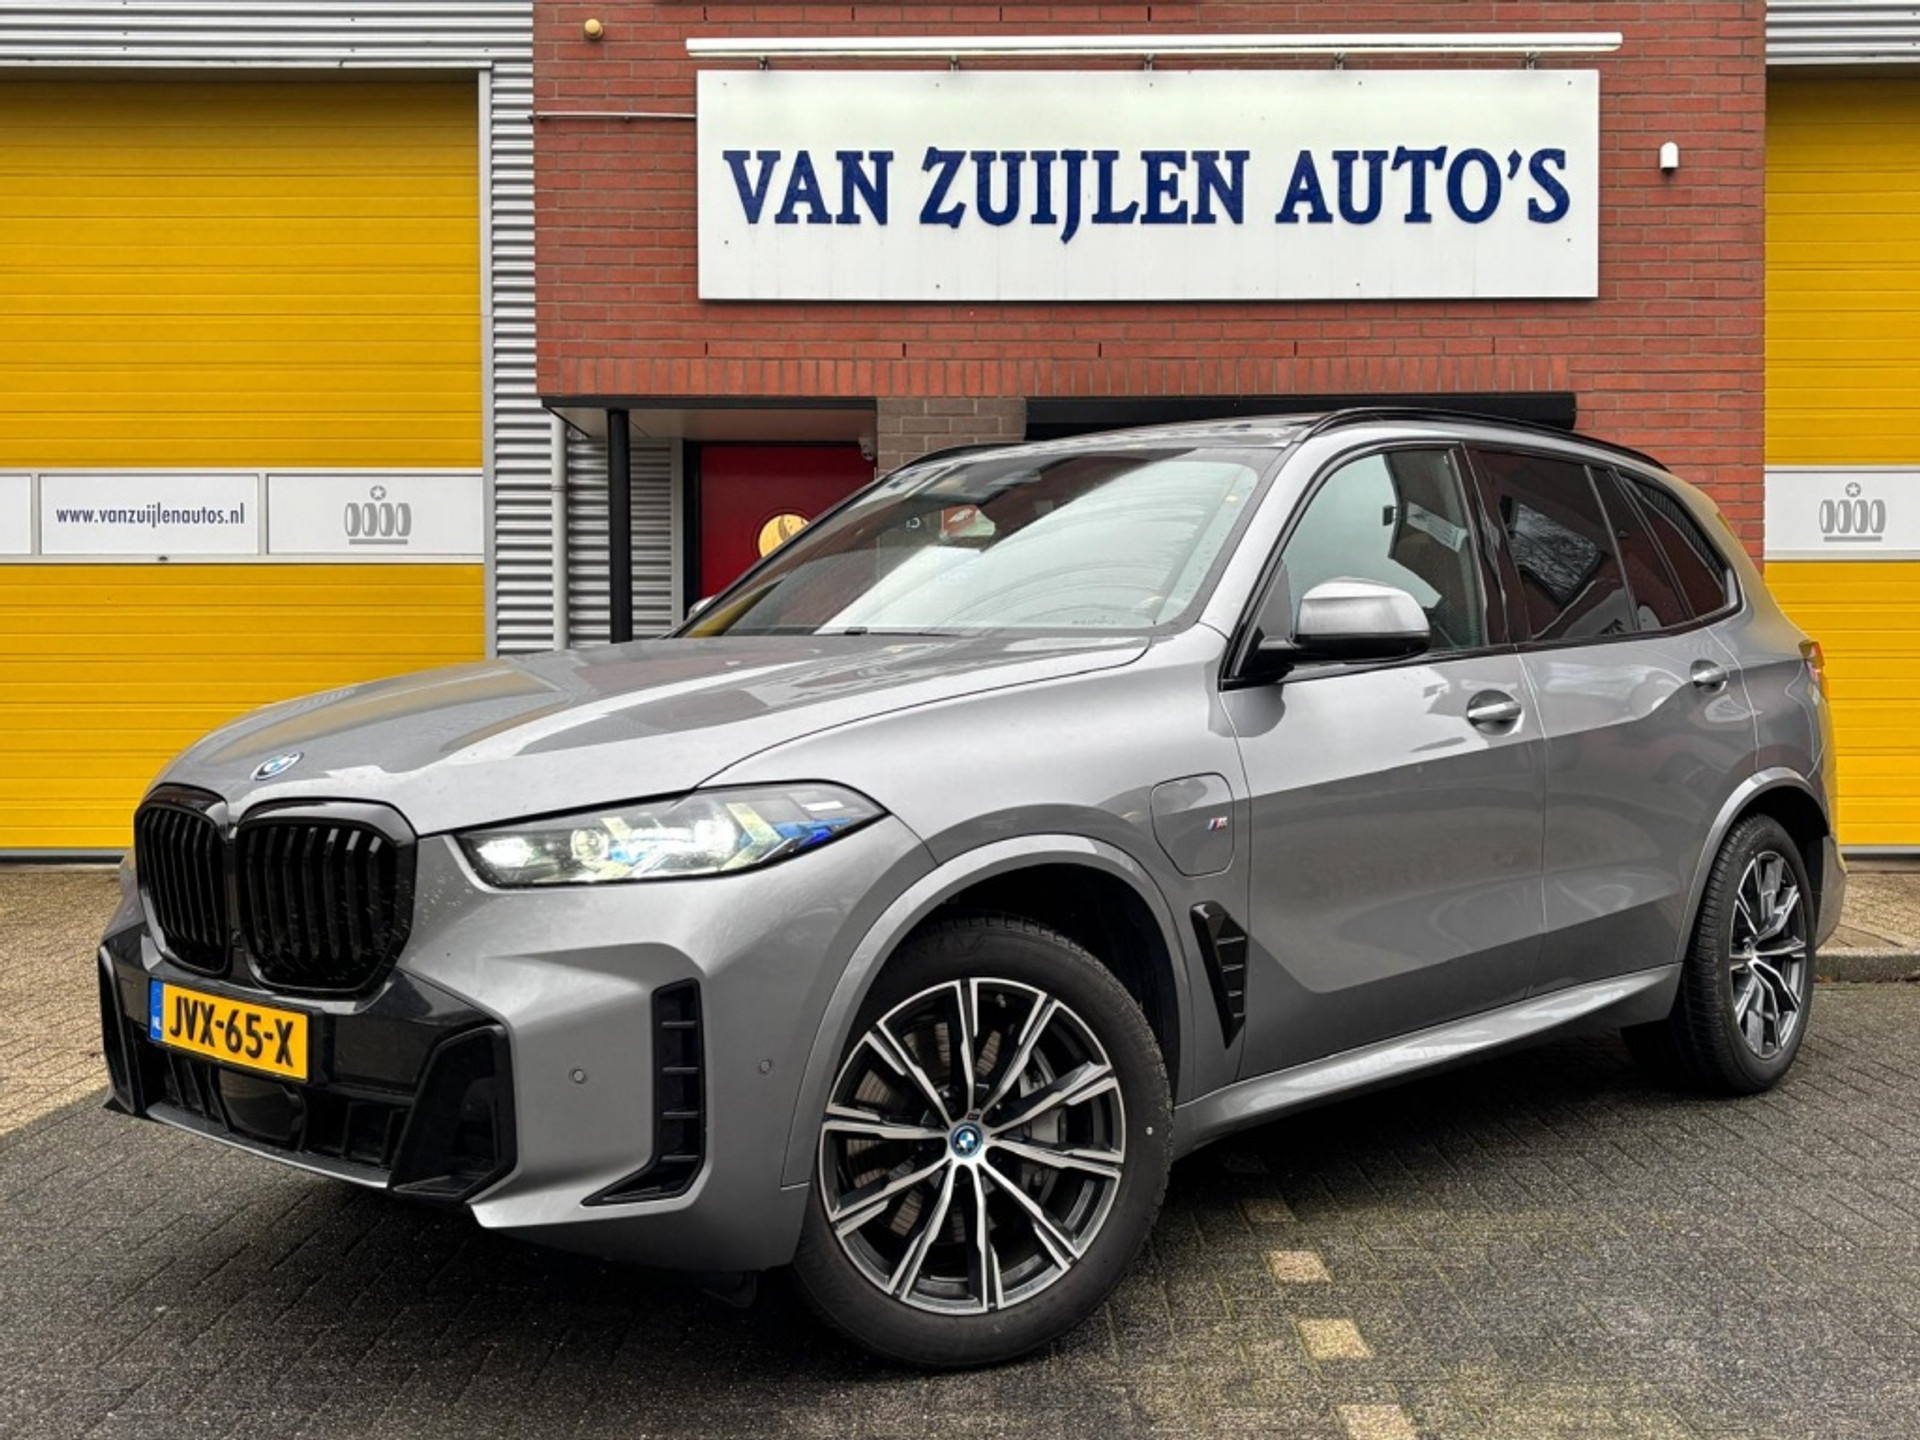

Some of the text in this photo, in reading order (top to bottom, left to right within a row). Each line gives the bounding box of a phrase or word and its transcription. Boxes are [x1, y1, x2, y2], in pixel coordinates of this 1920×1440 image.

[722, 145, 1572, 245] VAN ZUIJLEN AUTO'S
[56, 502, 245, 529] www.vanzuijlenautos.nl
[169, 995, 294, 1068] JVX-65-X
